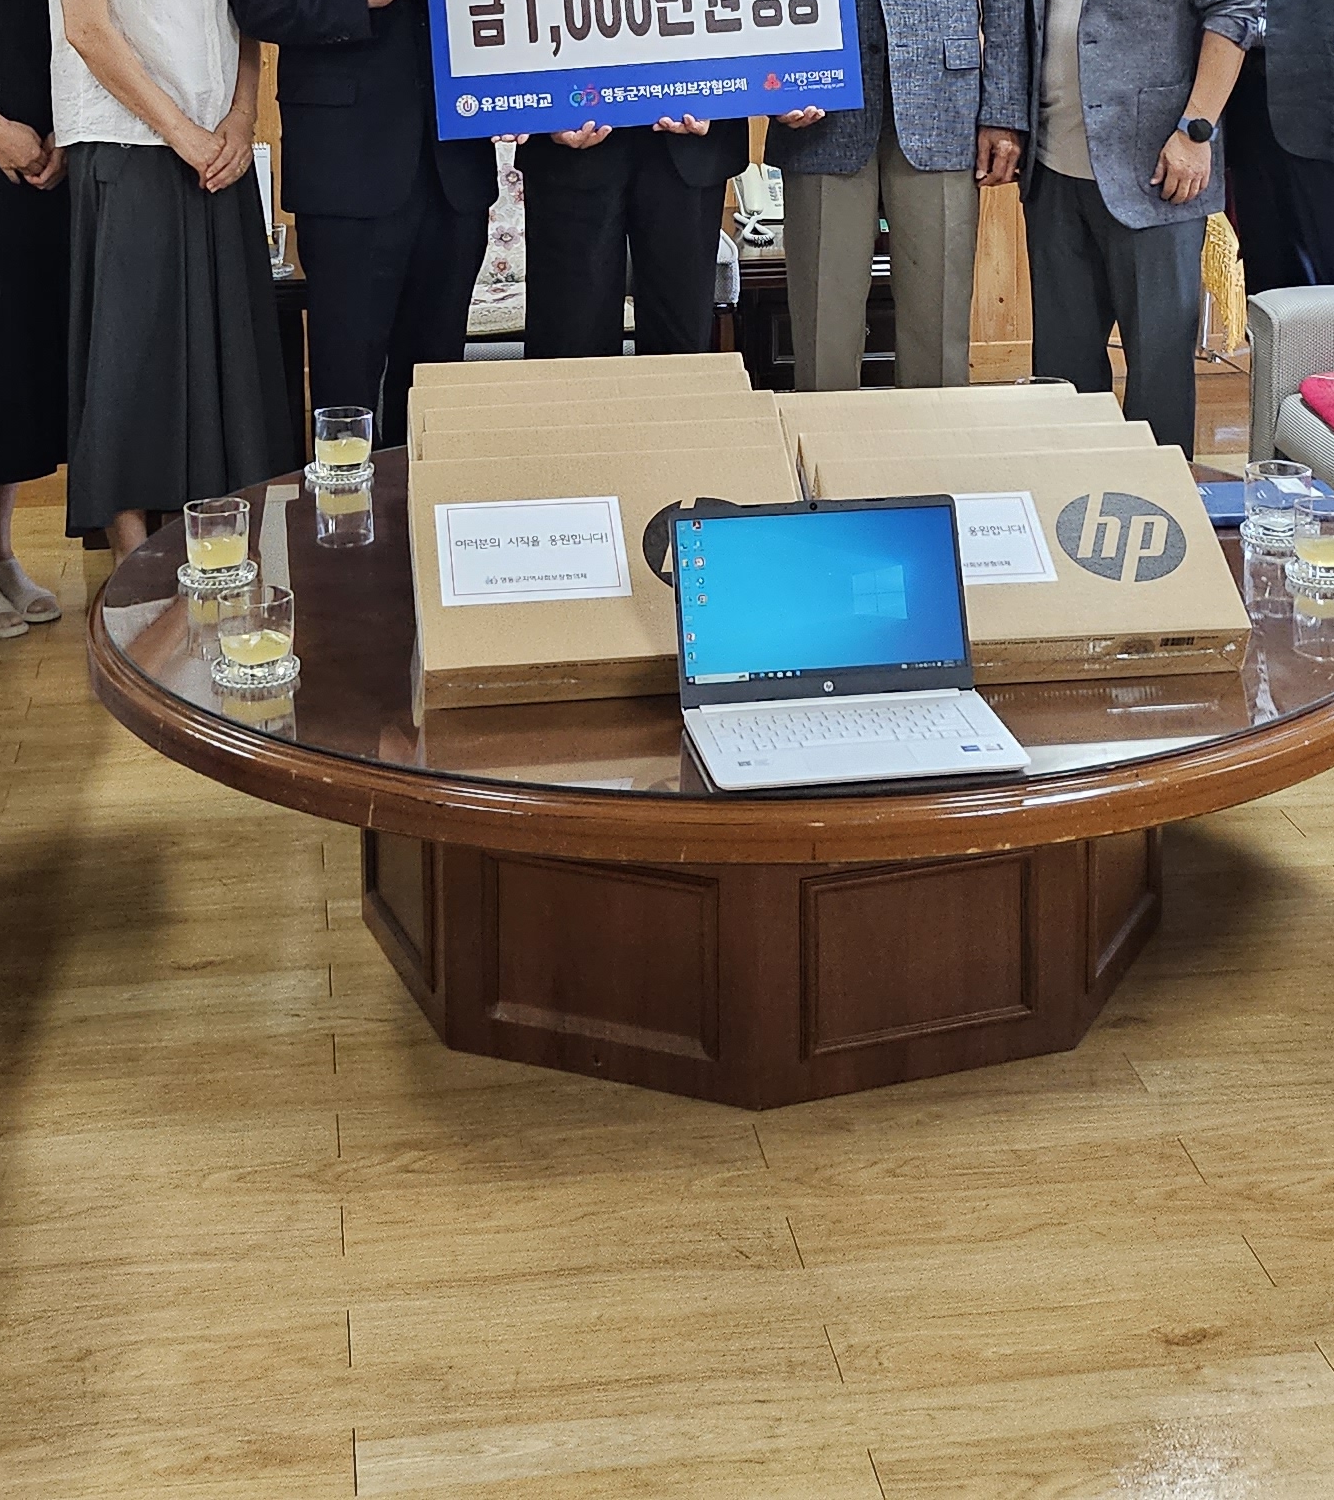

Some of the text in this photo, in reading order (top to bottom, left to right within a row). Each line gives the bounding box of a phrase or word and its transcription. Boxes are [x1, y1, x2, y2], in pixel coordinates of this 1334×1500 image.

[782, 68, 844, 86] 사랑의열매
[600, 77, 748, 103] 영동군지역사회보장협의체
[480, 92, 553, 112] 유원대학교
[455, 537, 501, 550] 여러분의
[548, 532, 609, 546] 응원합니다!
[1076, 491, 1170, 583] hp
